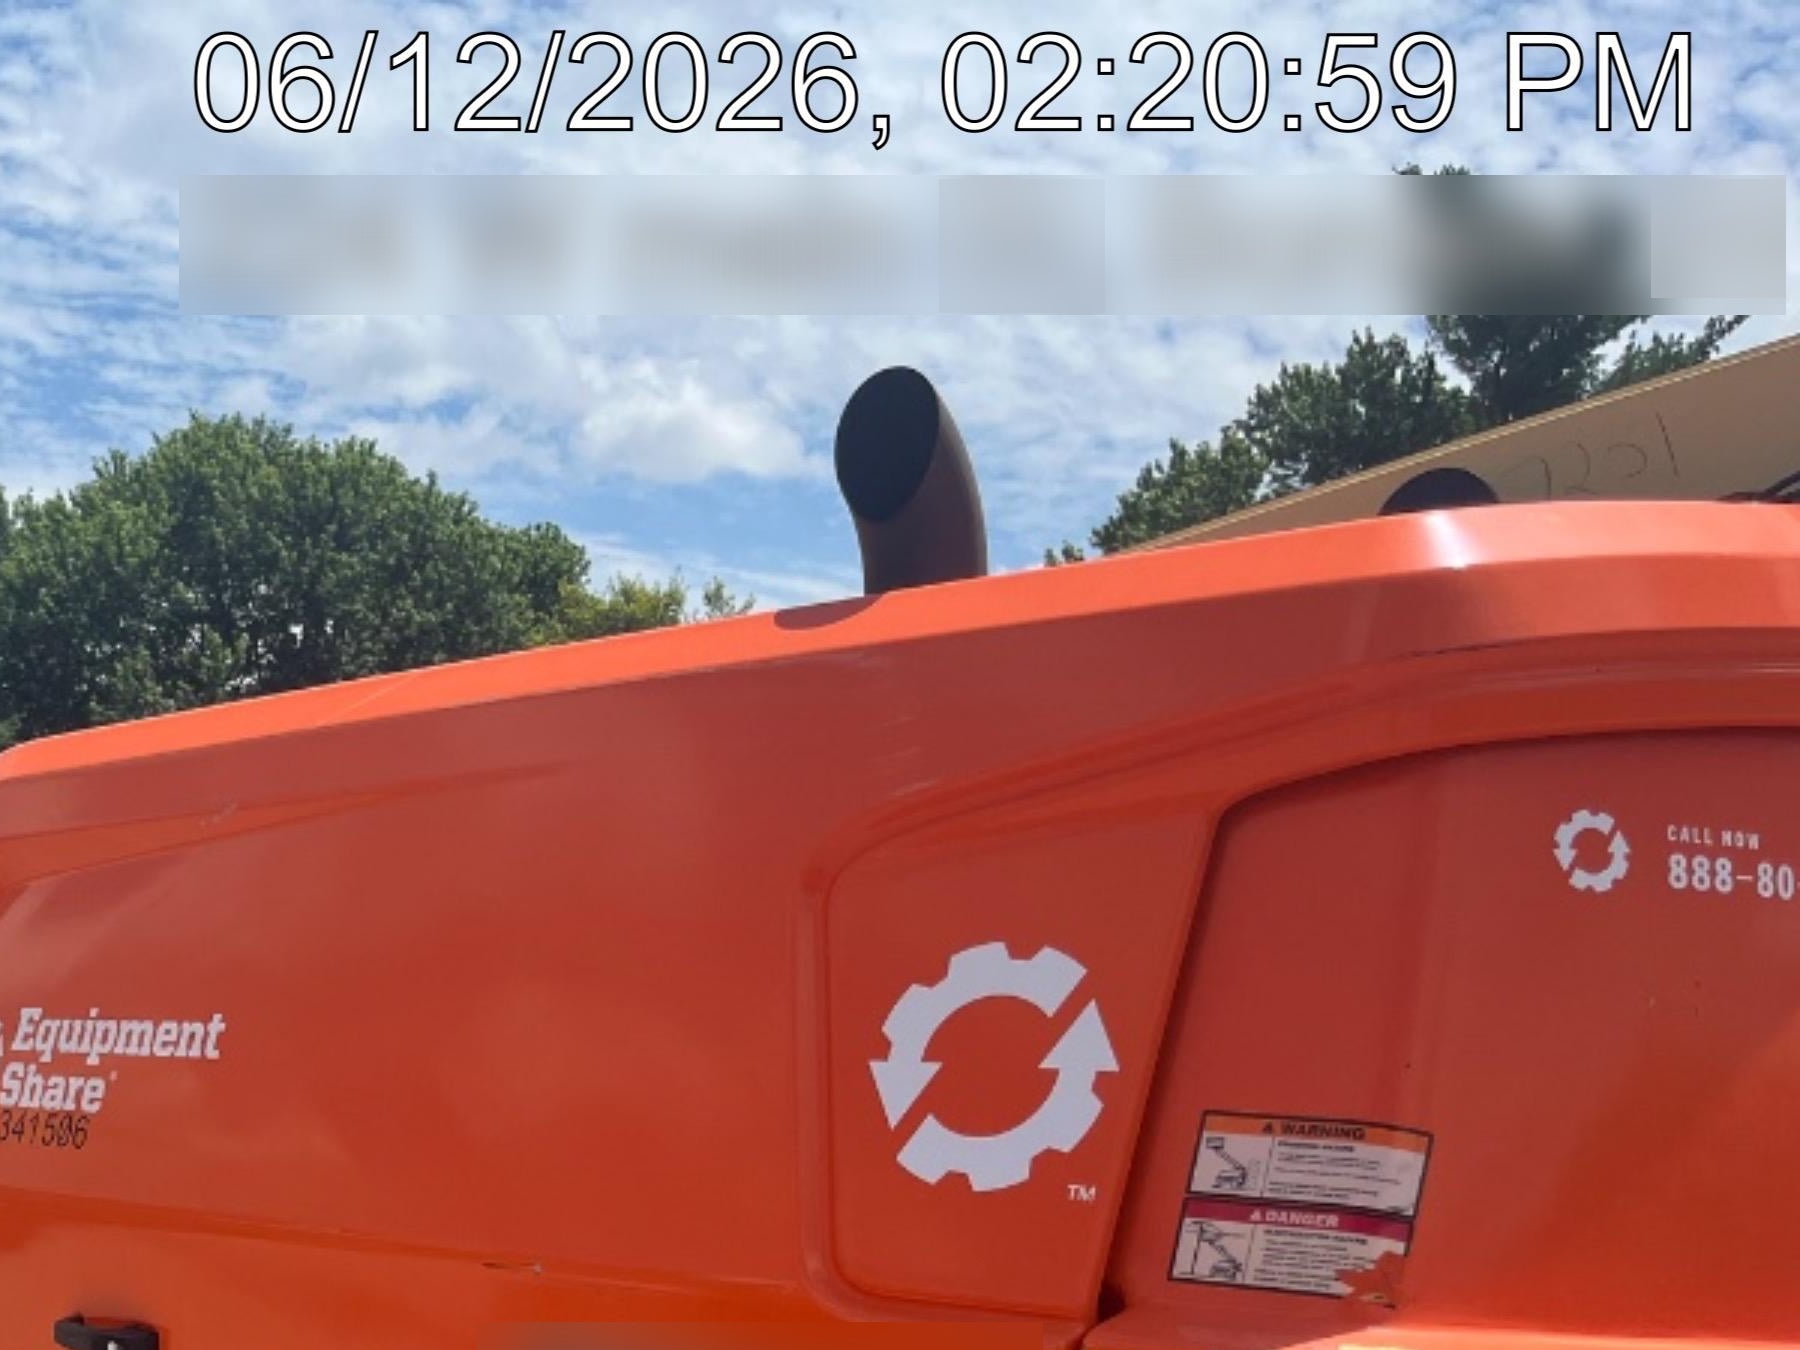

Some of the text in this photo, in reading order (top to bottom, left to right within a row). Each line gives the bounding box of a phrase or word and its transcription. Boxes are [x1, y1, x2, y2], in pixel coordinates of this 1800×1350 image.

[1667, 824, 1759, 850] CALL NOW
[1667, 853, 1800, 900] 888-80
[10, 1007, 226, 1066] Equipment
[1280, 1122, 1366, 1141] WARNING
[1067, 1184, 1096, 1203] TM
[1265, 1211, 1340, 1228] DANGER
